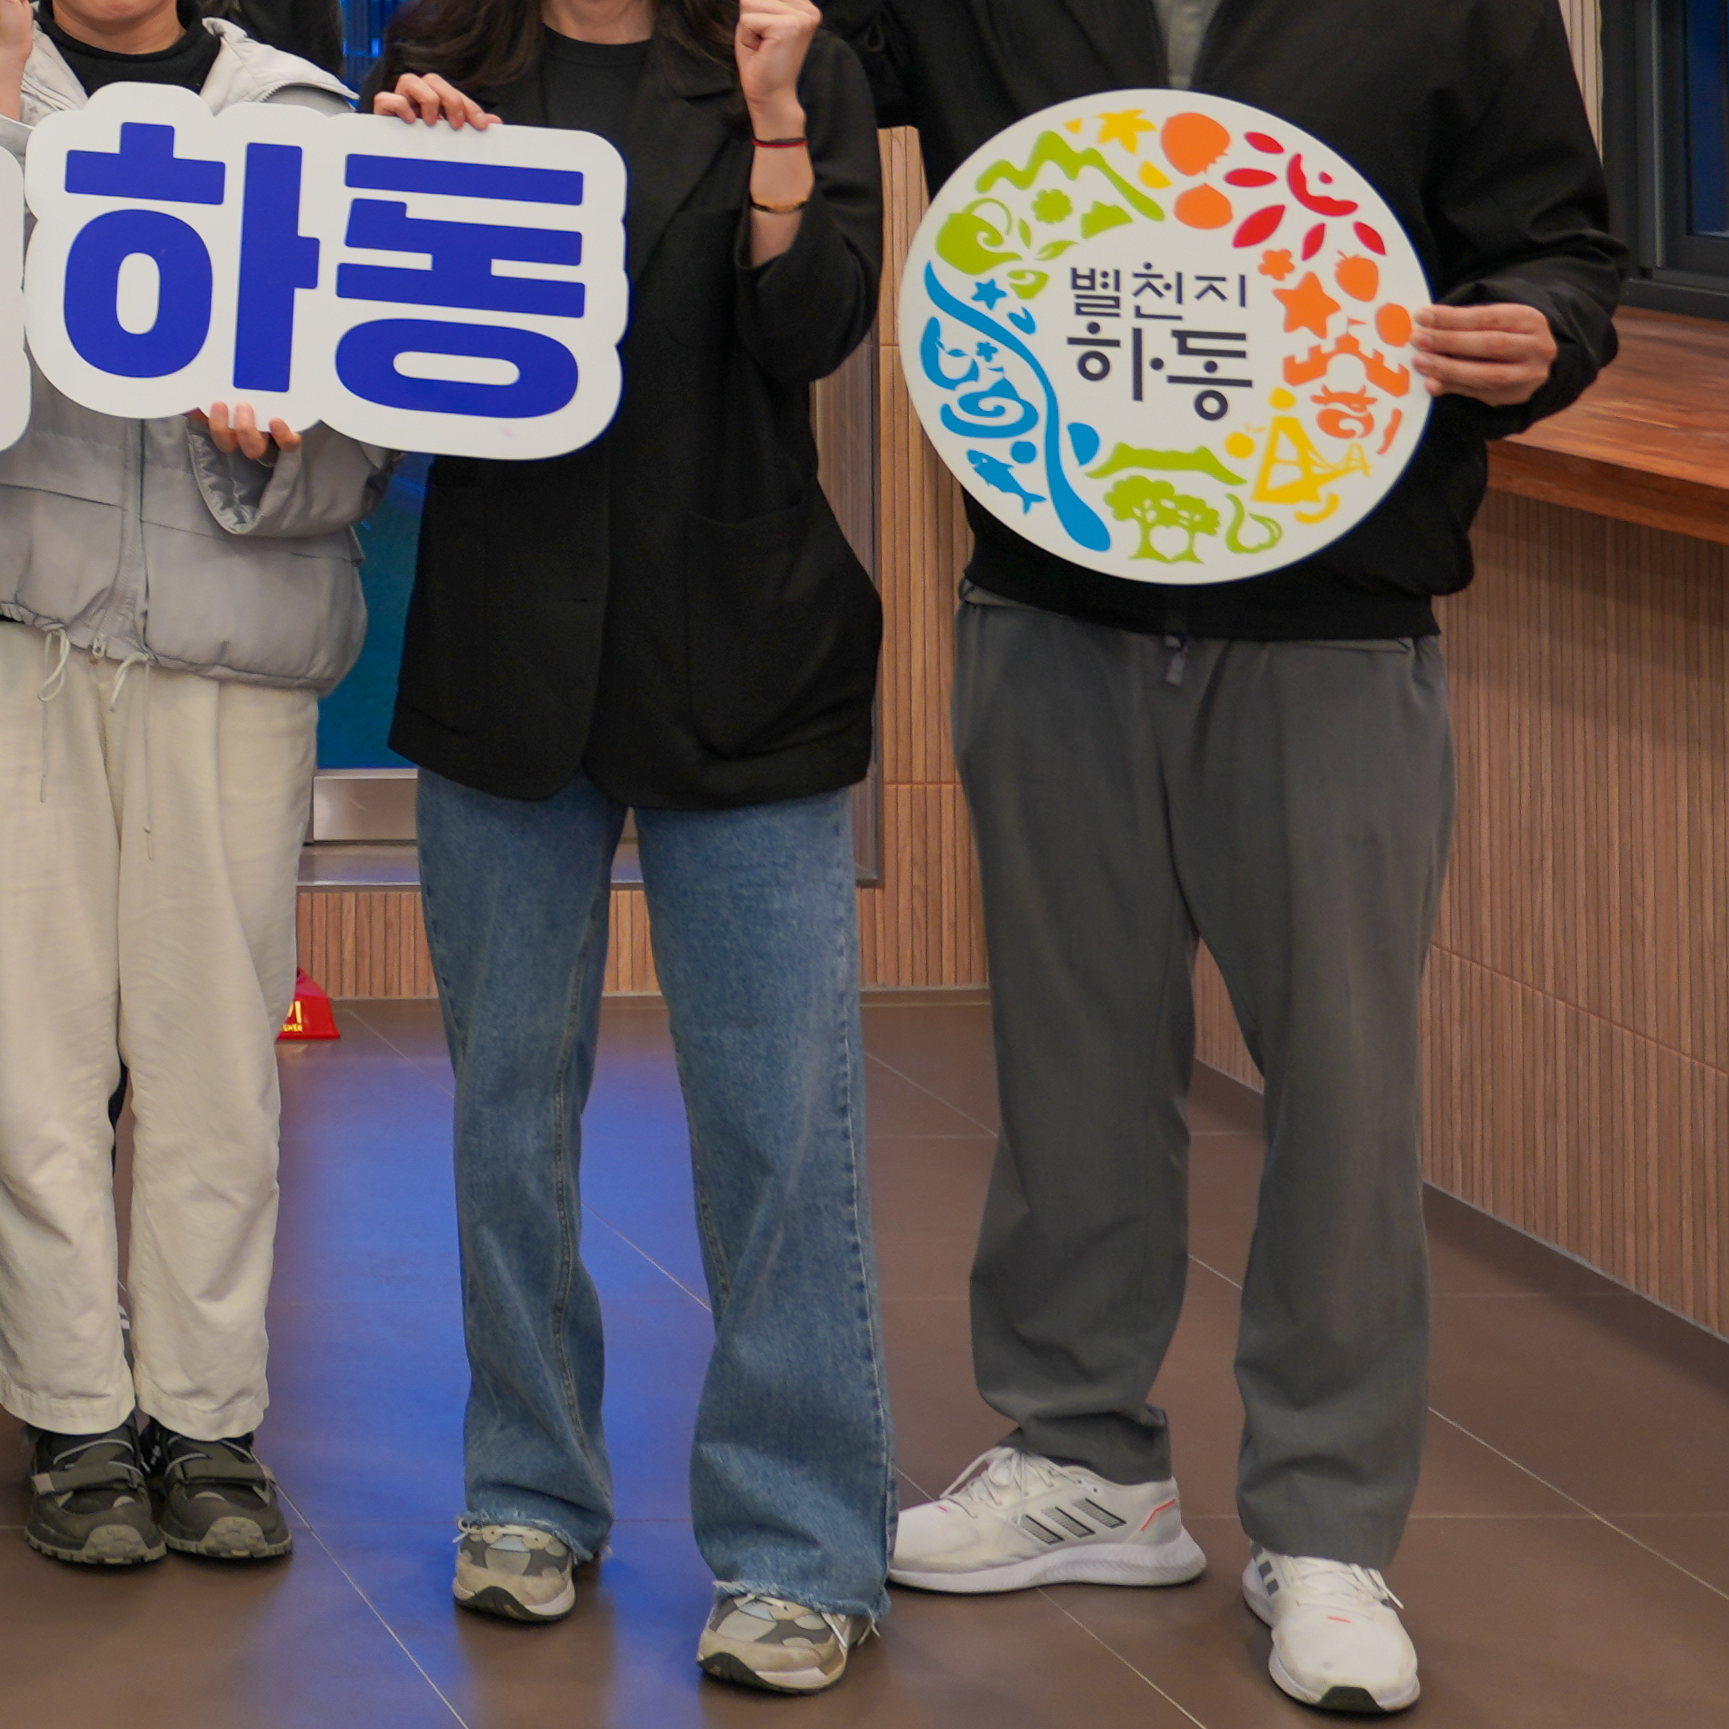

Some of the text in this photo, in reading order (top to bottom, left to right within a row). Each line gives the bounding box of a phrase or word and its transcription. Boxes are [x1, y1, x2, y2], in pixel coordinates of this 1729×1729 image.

[64, 122, 585, 420] 하동
[1070, 262, 1247, 322] 별천지
[1066, 322, 1253, 421] 하동
